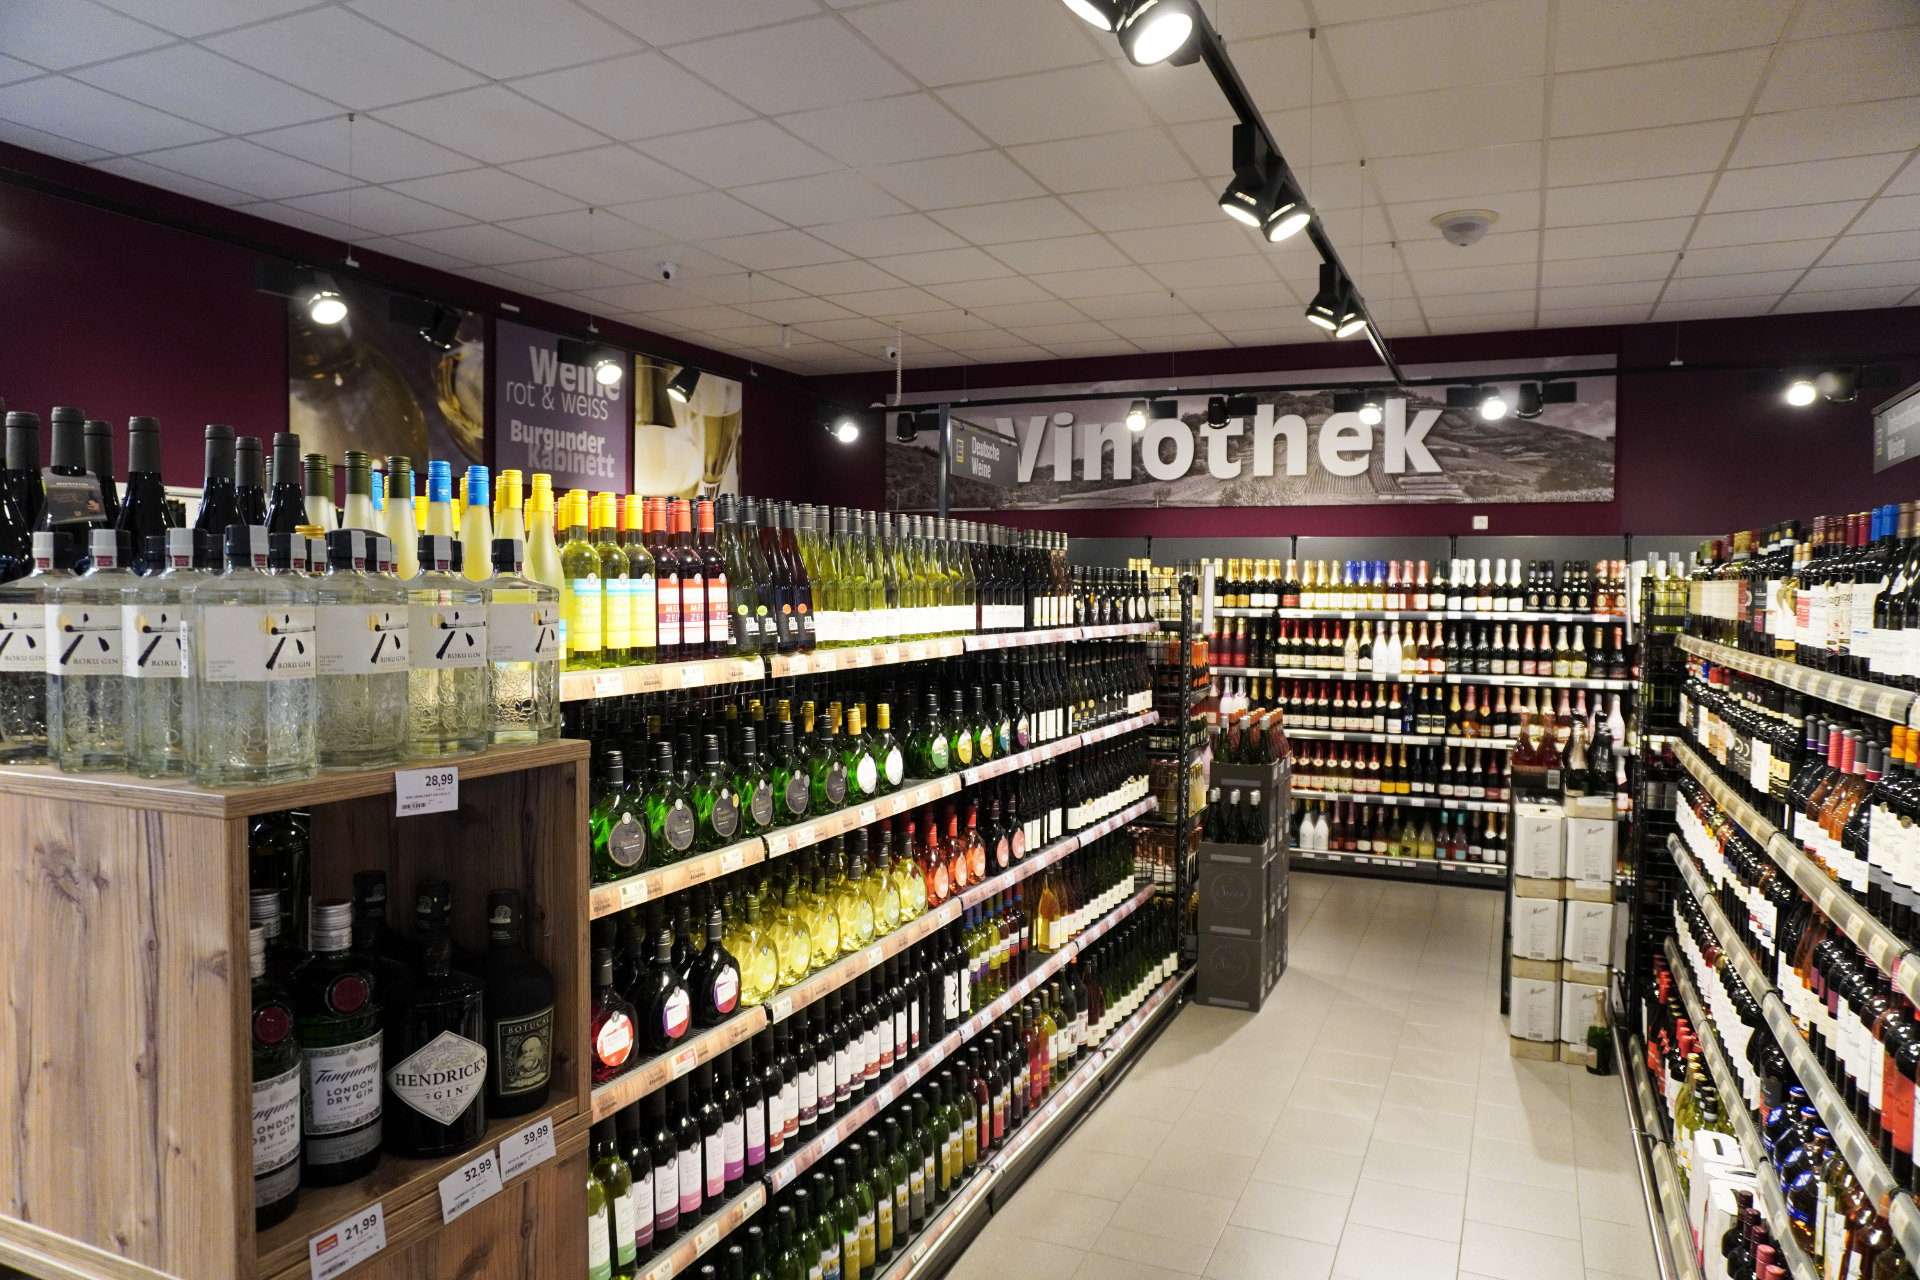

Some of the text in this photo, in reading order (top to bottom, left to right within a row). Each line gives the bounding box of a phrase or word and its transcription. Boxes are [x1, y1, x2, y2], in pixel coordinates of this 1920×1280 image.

[529, 345, 620, 401] Weine
[506, 381, 608, 420] rot & weiss
[511, 419, 605, 455] Burgunder
[972, 436, 1000, 461] Deutsche
[995, 398, 1443, 482] Vinothek
[528, 443, 615, 479] Kabinett
[971, 456, 992, 479] Weine
[380, 656, 395, 664] ROKU
[425, 773, 454, 787] 28,99
[314, 1059, 380, 1085] Tanqueray
[395, 1055, 487, 1087] HENDRICK'S
[327, 1077, 373, 1097] LONDON
[327, 1086, 373, 1106] DRY GIN
[433, 1085, 464, 1100] GIN
[256, 1113, 295, 1135] ONDON
[280, 1123, 295, 1136] GIN
[523, 1124, 549, 1146] 39,99
[464, 1158, 492, 1182] 32,99
[344, 1213, 377, 1241] 21,99
